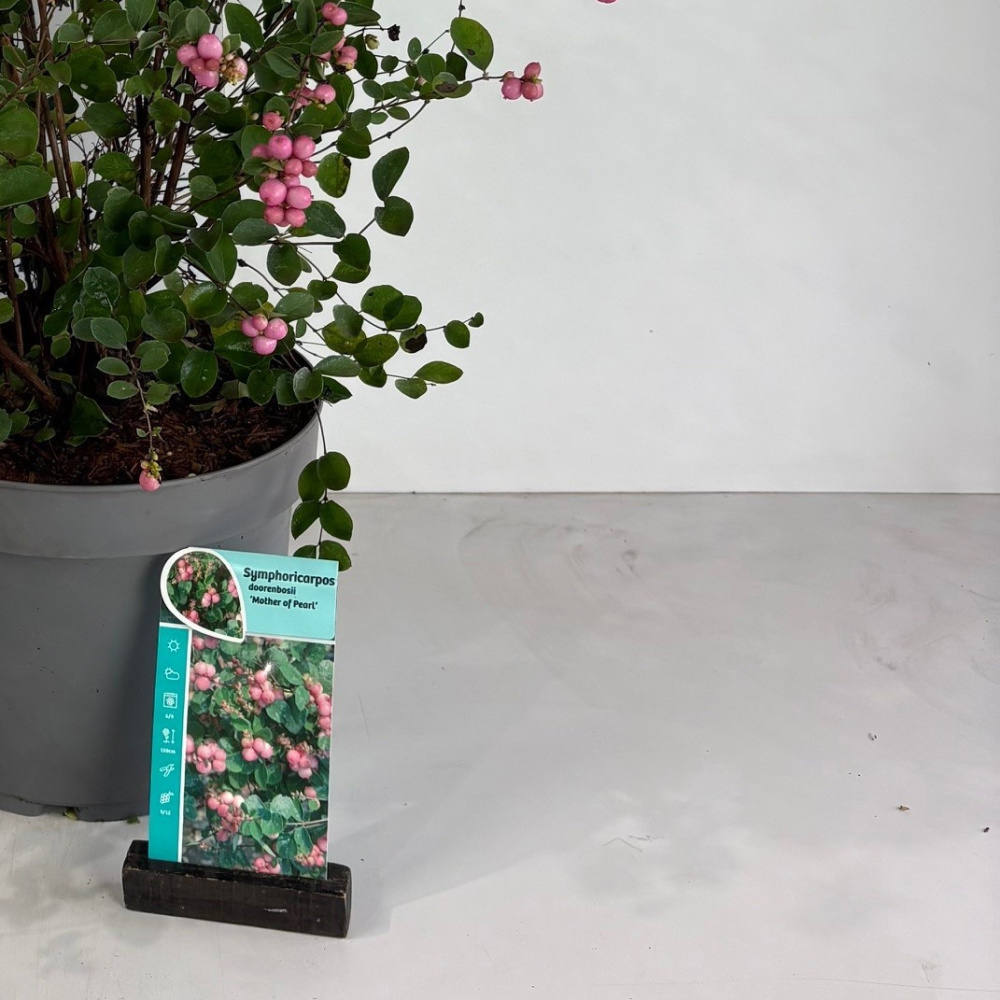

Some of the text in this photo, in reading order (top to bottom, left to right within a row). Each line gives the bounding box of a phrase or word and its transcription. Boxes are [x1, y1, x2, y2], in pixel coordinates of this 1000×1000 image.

[243, 567, 336, 588] Symphoricarpos
[248, 583, 297, 595] doorenbosii
[282, 599, 292, 609] of
